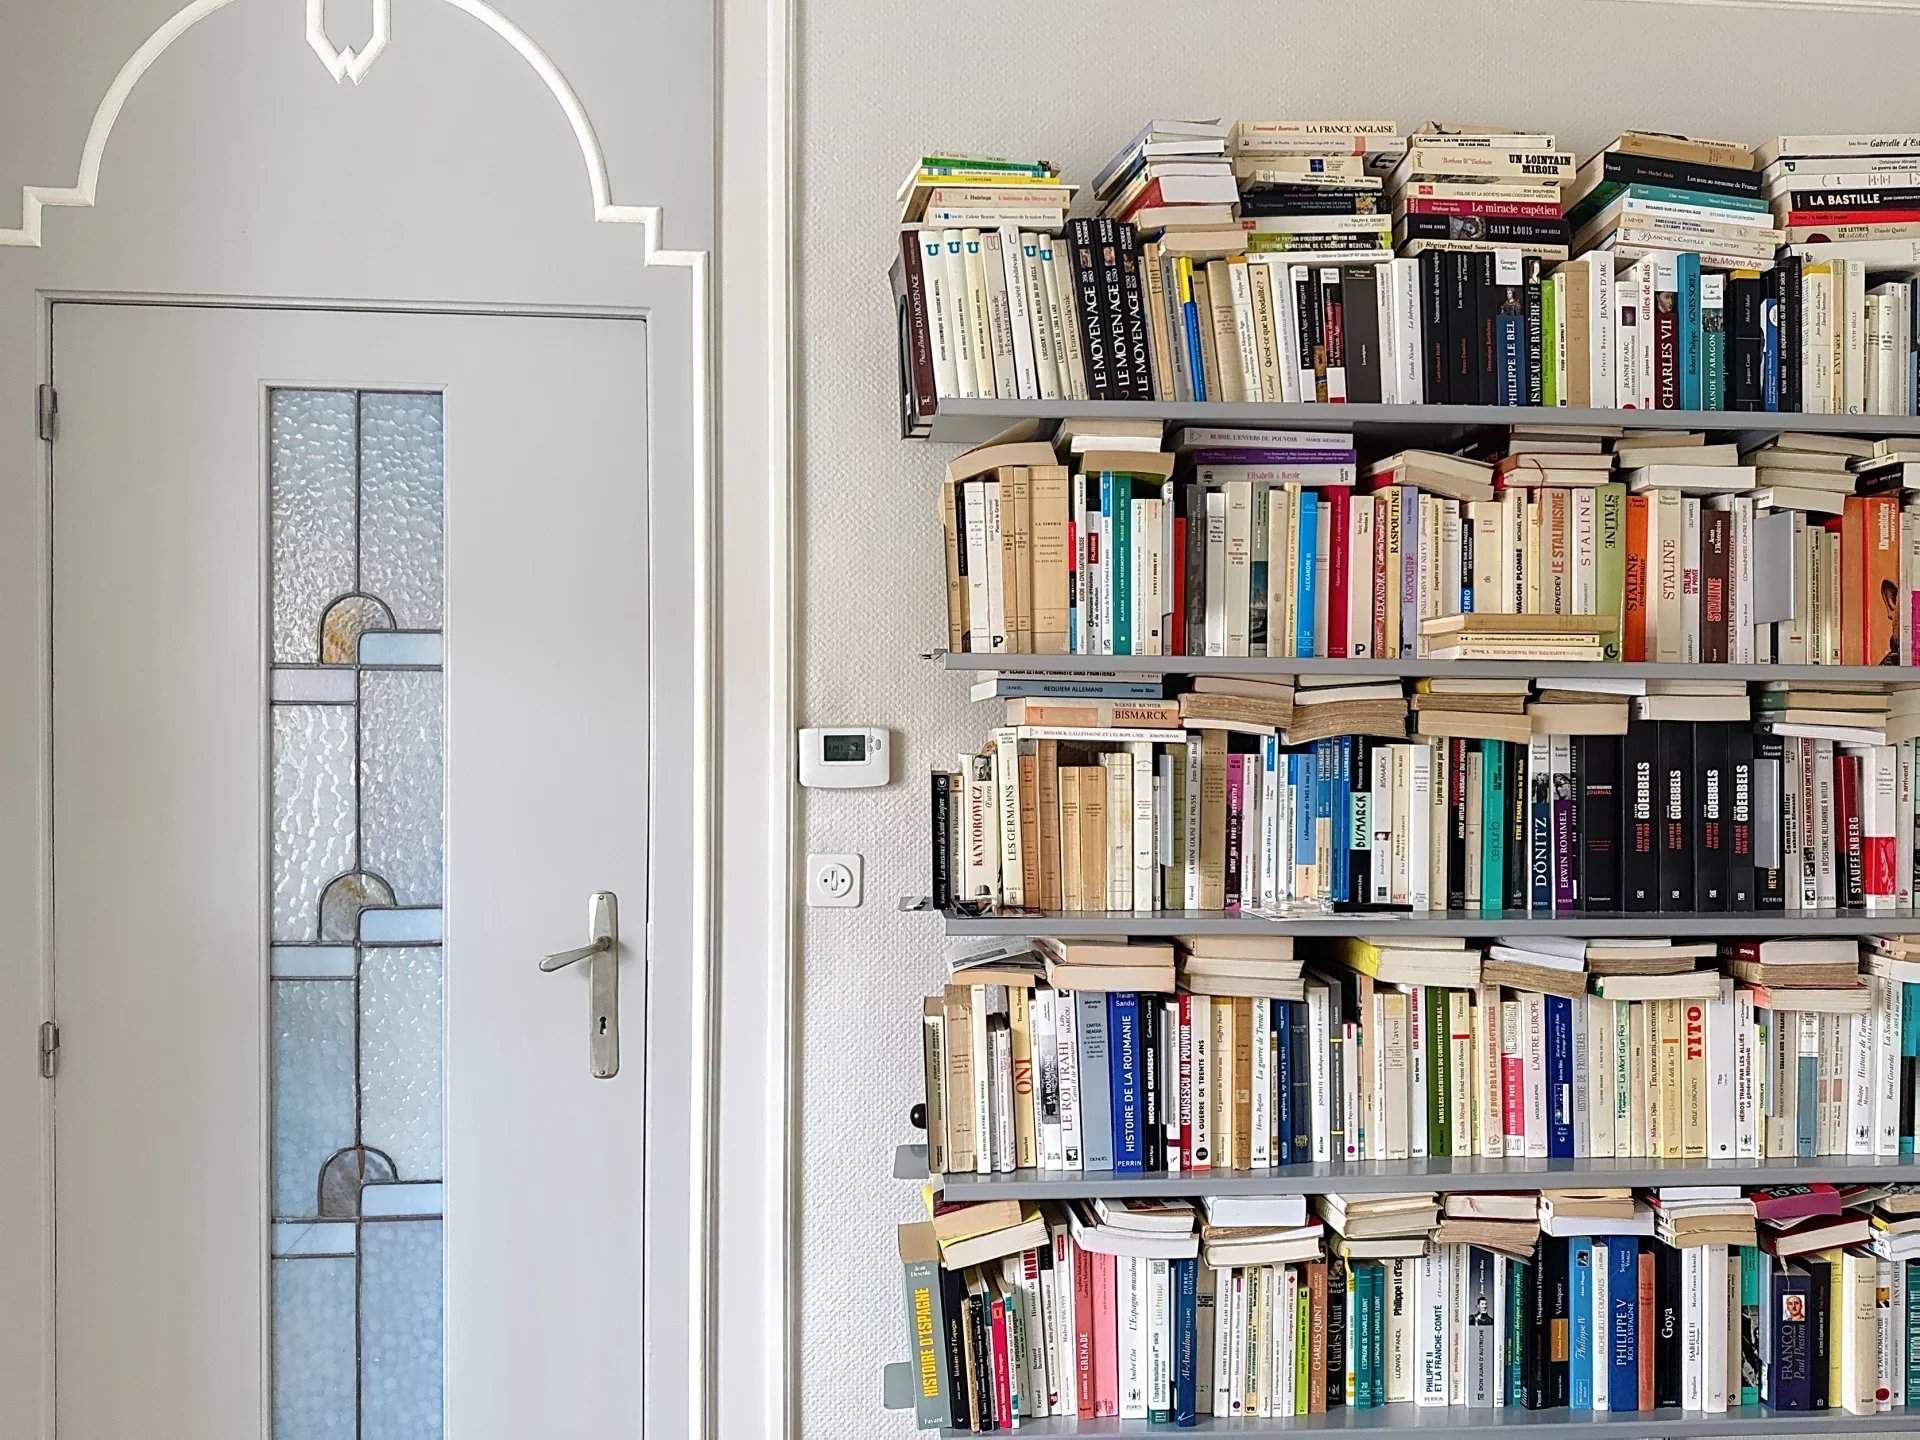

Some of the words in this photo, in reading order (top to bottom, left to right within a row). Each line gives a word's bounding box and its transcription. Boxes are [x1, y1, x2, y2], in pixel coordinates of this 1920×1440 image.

[1871, 138, 1899, 147] Gabrielle
[1509, 154, 1523, 163] UN
[1526, 155, 1571, 165] LOINTAIN
[1522, 165, 1558, 175] MIROIR
[1472, 203, 1484, 212] Le
[1486, 204, 1518, 213] miracle
[1521, 204, 1557, 215] capétien
[1810, 196, 1824, 205] LA
[1828, 194, 1880, 204] BASTILLE
[1490, 226, 1509, 234] SAINT
[1513, 226, 1533, 235] LOUIS
[1447, 241, 1472, 250] Pernoud
[1599, 261, 1607, 286] D'ARC
[1642, 264, 1650, 283] Rais
[913, 291, 922, 316] MOYEN
[1084, 286, 1098, 314] AGE
[1108, 284, 1119, 312] AGE
[1128, 291, 1139, 318] AGE
[1600, 288, 1608, 319] JEANNE
[1642, 286, 1650, 294] de
[916, 317, 923, 327] DU
[1527, 302, 1540, 342] BAVIÈRE
[1642, 297, 1651, 320] Gilles
[1086, 316, 1105, 369] MOYEN
[1110, 314, 1127, 367] MOYEN
[1506, 321, 1515, 340] BEL
[1661, 320, 1672, 338] VII
[1130, 320, 1147, 373] MOYEN
[1507, 344, 1515, 355] LE
[1530, 346, 1540, 359] DE
[1095, 372, 1107, 388] LE
[1118, 370, 1130, 386] LE
[1137, 376, 1149, 391] LE
[1507, 359, 1518, 407] PHILIPPE
[1530, 362, 1541, 402] ISABEAU
[1662, 343, 1674, 408] CHARLES
[1390, 490, 1400, 554] RASPOUTINE
[1552, 493, 1564, 558] STALINISME
[1581, 496, 1590, 566] STALINE
[1605, 494, 1615, 548] STALINE
[1405, 553, 1414, 603] RASPOUTINE
[1552, 561, 1563, 573] LE
[1663, 540, 1675, 600] STALINE
[1683, 568, 1692, 594] STALINE
[1627, 554, 1638, 611] STALINE
[1708, 578, 1721, 621] STALINE
[1115, 711, 1168, 720] BISMARCK
[1638, 762, 1649, 819] GOEBBELS
[1670, 770, 1681, 819] GOEBBELS
[1707, 770, 1719, 818] GOEBBELS
[1736, 765, 1748, 821] GOEBBELS
[972, 786, 983, 866] KANTOROWICZ
[1005, 785, 1016, 841] GERMAINS
[1355, 796, 1366, 848] BISMARCK
[1559, 810, 1567, 853] ROMMEL
[1635, 823, 1643, 852] Journal
[1008, 843, 1016, 861] LES
[1533, 817, 1546, 886] DÖNITZ
[1849, 817, 1861, 893] STAUFFENBERG
[1560, 856, 1568, 888] ERWIN
[1768, 868, 1776, 889] HEYD
[1884, 981, 1892, 1010] militaire
[1256, 1014, 1264, 1034] Trente
[1531, 1000, 1539, 1034] EUROPE
[1883, 1011, 1892, 1034] Société
[1122, 1016, 1132, 1069] ROUMANIE
[1180, 1025, 1190, 1061] POUVOIR
[1391, 1021, 1400, 1045] L'aveu
[1687, 1007, 1702, 1060] TITO
[1884, 1036, 1892, 1046] La
[1059, 1042, 1071, 1085] TRAHI
[1257, 1045, 1265, 1068] guerre
[1532, 1036, 1540, 1071] L'AUTRE
[1575, 1033, 1585, 1070] FRONTIÈRES
[1015, 1058, 1032, 1094] ONI
[1124, 1073, 1133, 1085] LA
[1180, 1065, 1190, 1075] AU
[1256, 1071, 1263, 1080] La
[1576, 1074, 1585, 1082] DE
[1619, 1074, 1625, 1083] La
[1060, 1088, 1071, 1110] ROI
[1124, 1088, 1133, 1101] DE
[1180, 1077, 1191, 1125] CEAUSESCU
[1199, 1088, 1205, 1097] DE
[1577, 1085, 1586, 1112] HISTOIRE
[1061, 1114, 1072, 1131] LE
[1123, 1105, 1135, 1152] HISTOIRE
[1199, 1133, 1205, 1142] LA
[1023, 1248, 1037, 1280] MADRI
[1028, 1282, 1035, 1290] de
[1555, 1283, 1563, 1315] Vélasquez
[914, 1288, 934, 1346] D'ESPAGNE
[1328, 1304, 1344, 1332] Quint
[1616, 1299, 1627, 1308] V
[1314, 1304, 1322, 1333] QUINT
[1662, 1307, 1675, 1338] Goya
[1080, 1332, 1089, 1370] GRENADE
[1433, 1305, 1442, 1369] FRANCHE-COMTÉ
[1616, 1312, 1628, 1365] PHILIPPE
[1794, 1325, 1805, 1356] Preston
[1313, 1334, 1322, 1370] CHARLES
[1328, 1334, 1342, 1371] Charles
[1781, 1325, 1793, 1380] FRANCO
[920, 1349, 939, 1398] HISTOIRE
[1435, 1371, 1442, 1381] LA
[1794, 1359, 1806, 1379] Paul
[1435, 1383, 1442, 1392] ET
